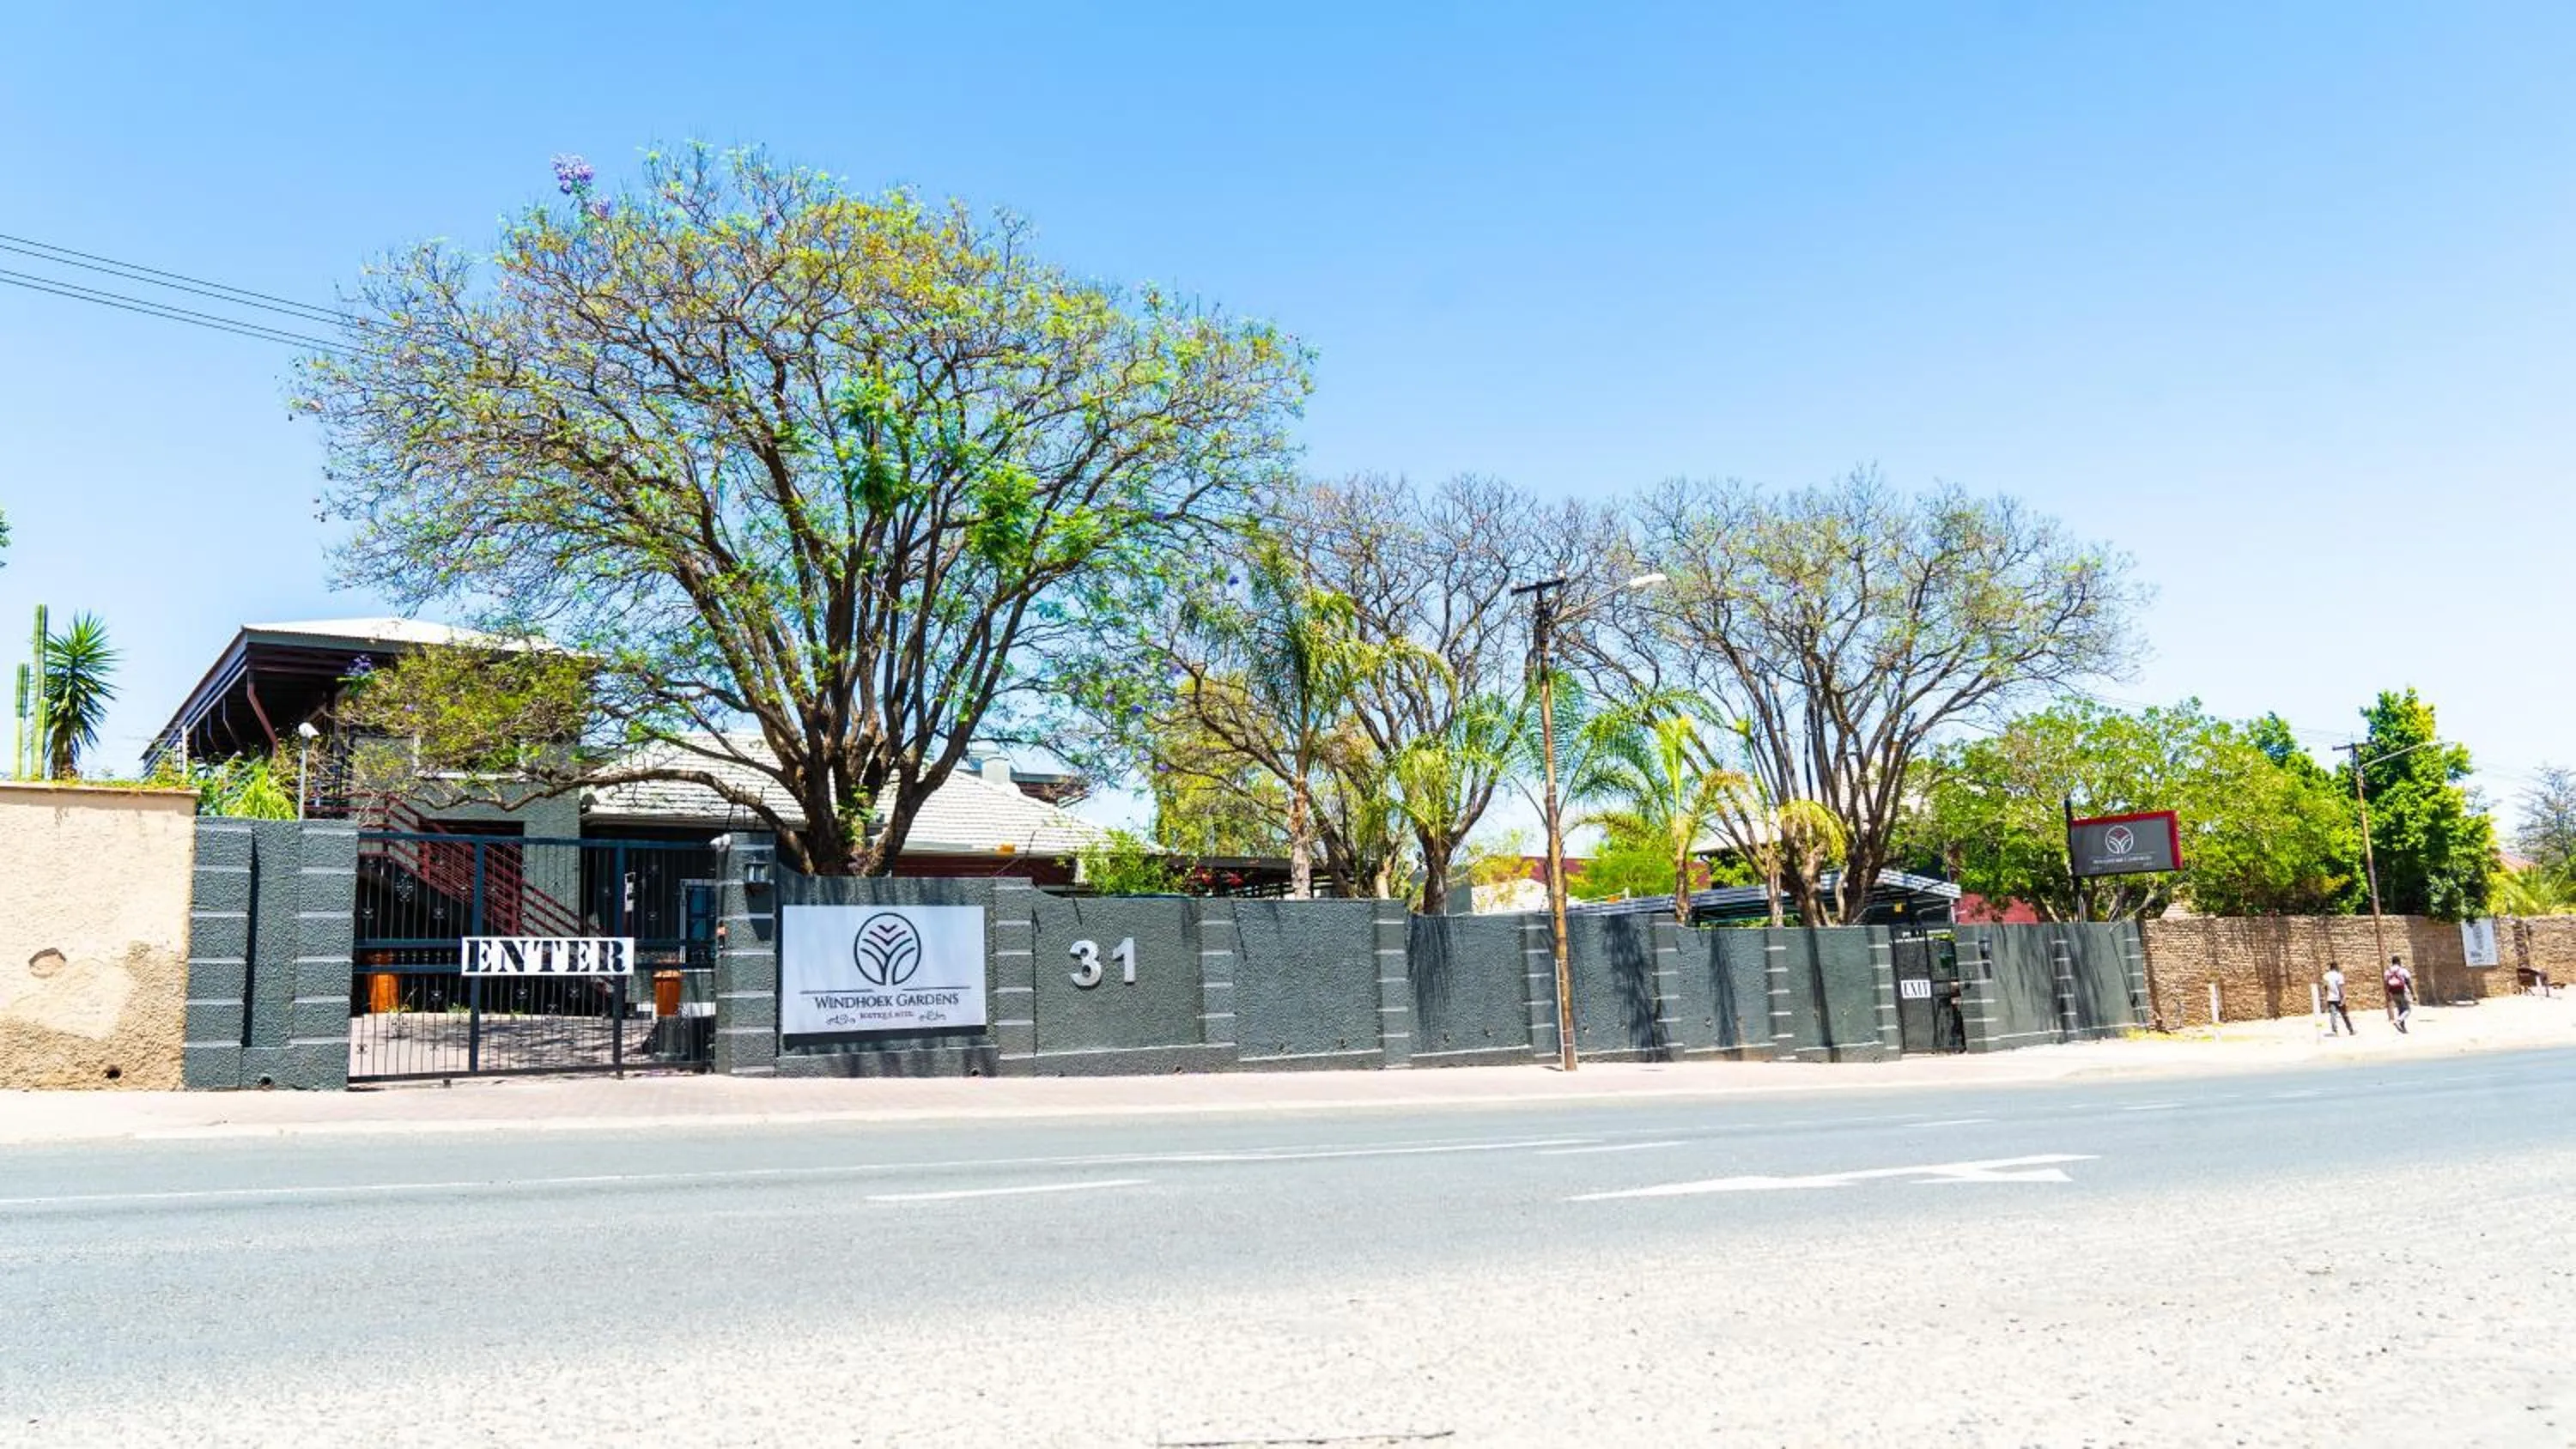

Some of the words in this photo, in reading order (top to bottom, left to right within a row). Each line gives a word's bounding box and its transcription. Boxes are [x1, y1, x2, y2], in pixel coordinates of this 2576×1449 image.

[465, 940, 625, 973] ENTER
[1069, 937, 1136, 988] 31
[815, 996, 892, 1009] WINDHOEK
[896, 993, 959, 1007] GARDENS
